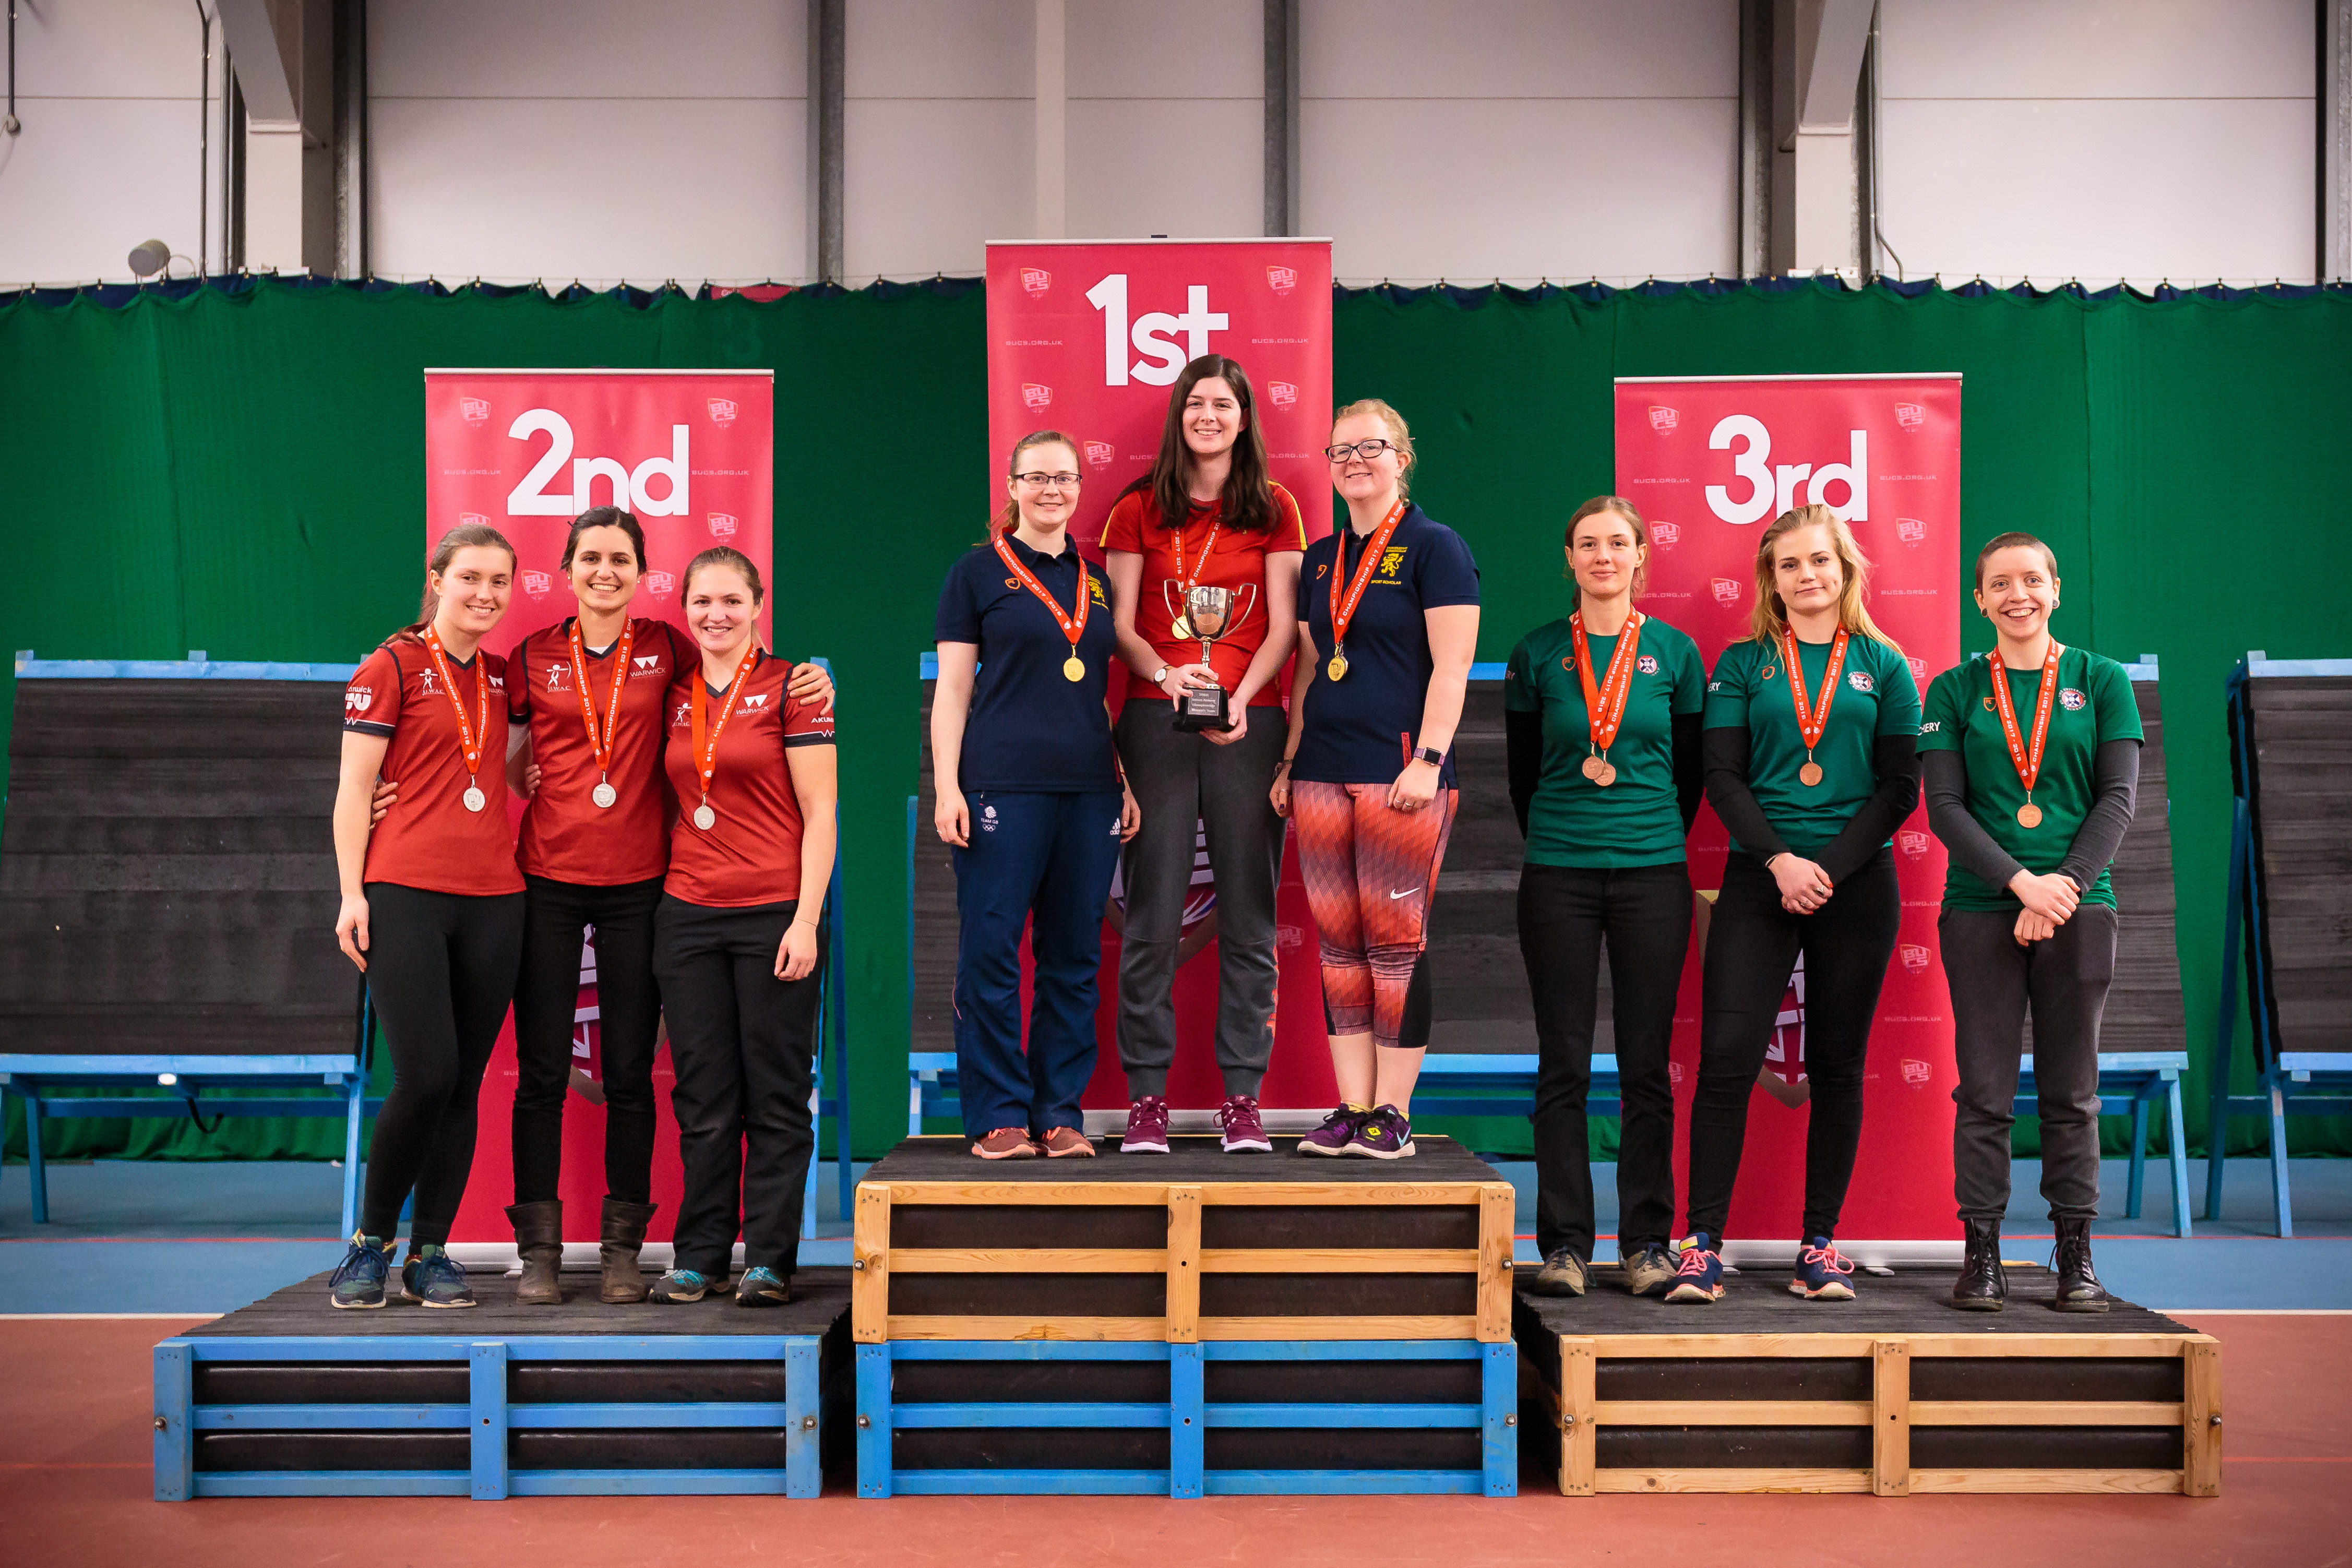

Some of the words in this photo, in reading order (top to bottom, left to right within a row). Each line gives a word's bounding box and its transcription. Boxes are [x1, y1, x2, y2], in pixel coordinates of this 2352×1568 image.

[1085, 274, 1229, 386] 1st
[507, 409, 689, 516] 2nd
[1705, 414, 1868, 524] 3rd
[1193, 531, 1215, 578] CHAMPIONSHIP
[1342, 567, 1369, 616] CHAMPIONSHIP
[1368, 549, 1379, 566] 2017
[1378, 529, 1389, 545] 2018
[1000, 546, 1032, 583] CHAMPIONSHIP
[1031, 583, 1046, 596] 2017
[1048, 601, 1062, 616] 2018
[574, 644, 587, 696] CHAMPIONSHIP
[630, 667, 666, 677] WARWICK
[1611, 629, 1631, 675] CHAMPIONSHIP
[1786, 637, 1798, 679] CHAMPIONSHIP
[435, 652, 458, 701] CHAMPIONSHIP
[455, 702, 464, 720] 2017
[722, 672, 745, 719] CHAMPIONSHIP
[1598, 697, 1606, 712] 2018
[1605, 675, 1614, 691] 2017
[1611, 674, 1627, 722] CHAMPIONSHIP
[1817, 677, 1833, 725] CHAMPIONSHIP
[478, 700, 486, 749] CHAMPIONSHIP
[606, 688, 618, 742] CHAMPIONSHIP
[713, 721, 723, 737] 2017
[1996, 671, 2010, 719] CHAMPIONSHIP
[2007, 720, 2015, 737] 2017
[2013, 743, 2022, 762] 2018
[2033, 710, 2046, 762] CHAMPIONSHIP
